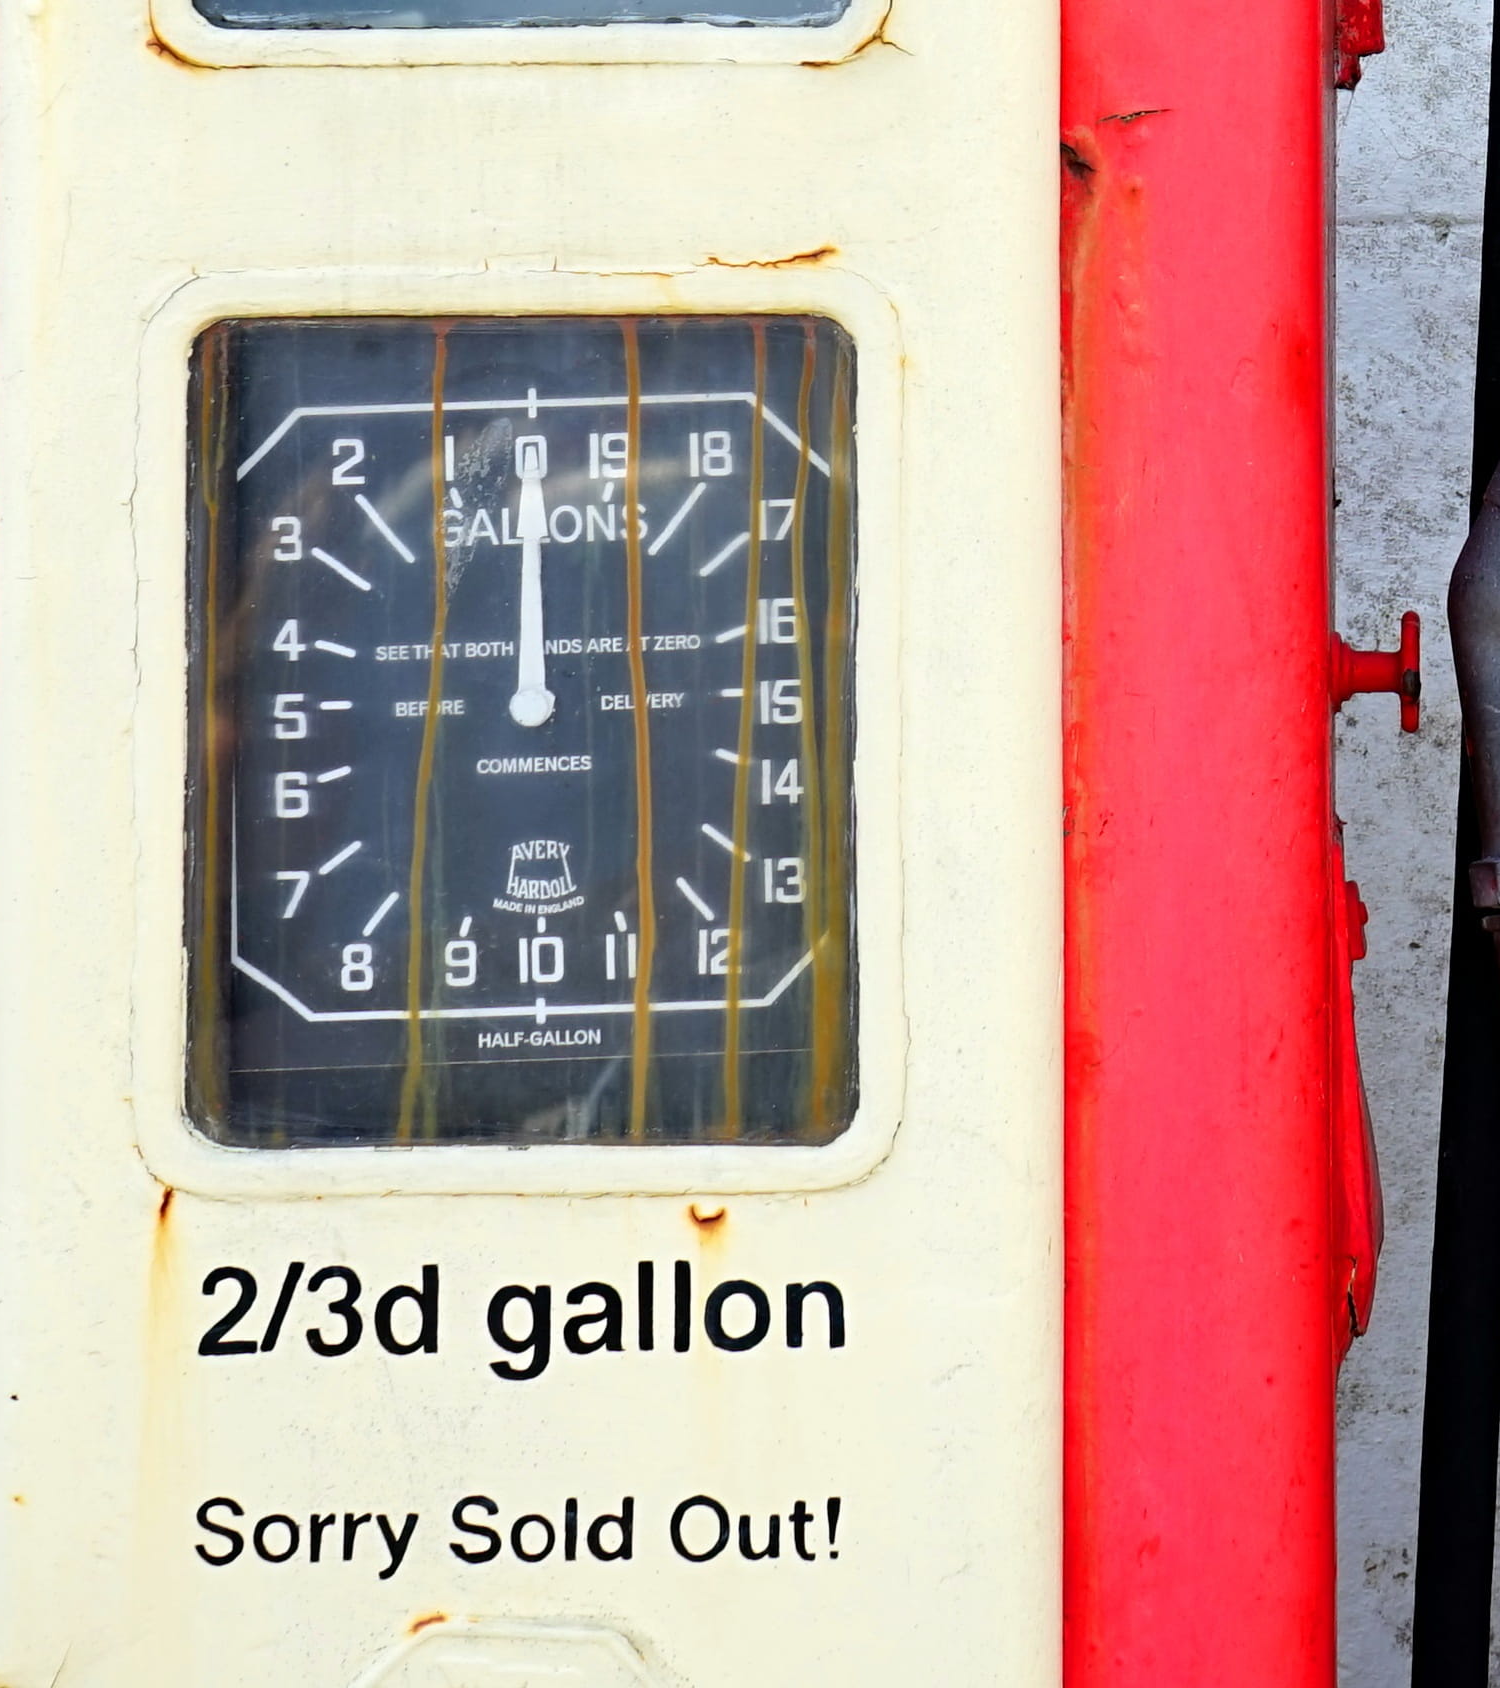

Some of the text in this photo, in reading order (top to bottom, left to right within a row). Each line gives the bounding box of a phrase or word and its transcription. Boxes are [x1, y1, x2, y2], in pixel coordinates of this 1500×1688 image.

[331, 430, 733, 486] 2 1 0 19 18
[271, 517, 303, 562] 3
[440, 503, 648, 546] GALONS
[759, 499, 796, 540] 17
[272, 618, 306, 660] 4
[757, 598, 800, 645] 16
[375, 645, 409, 661] SEE
[465, 642, 514, 657] BOTH
[586, 636, 622, 653] ARE
[654, 635, 700, 650] ZERO
[273, 695, 307, 739] 5
[760, 679, 803, 725] 15
[477, 755, 592, 774] COMMENCES
[761, 758, 804, 805] 14
[274, 773, 309, 818] 6
[511, 839, 570, 860] AVERY
[277, 871, 311, 919] 7
[506, 875, 577, 900] HARDOLL
[764, 857, 806, 903] 13
[492, 896, 585, 914] MADE IN ENGLAND
[340, 928, 741, 992] 8 9 10 11 12
[478, 1029, 601, 1049] HALF-GALLON
[197, 1259, 846, 1380] 2/3d gallon
[193, 1496, 843, 1579] Sorry Sold Out!
